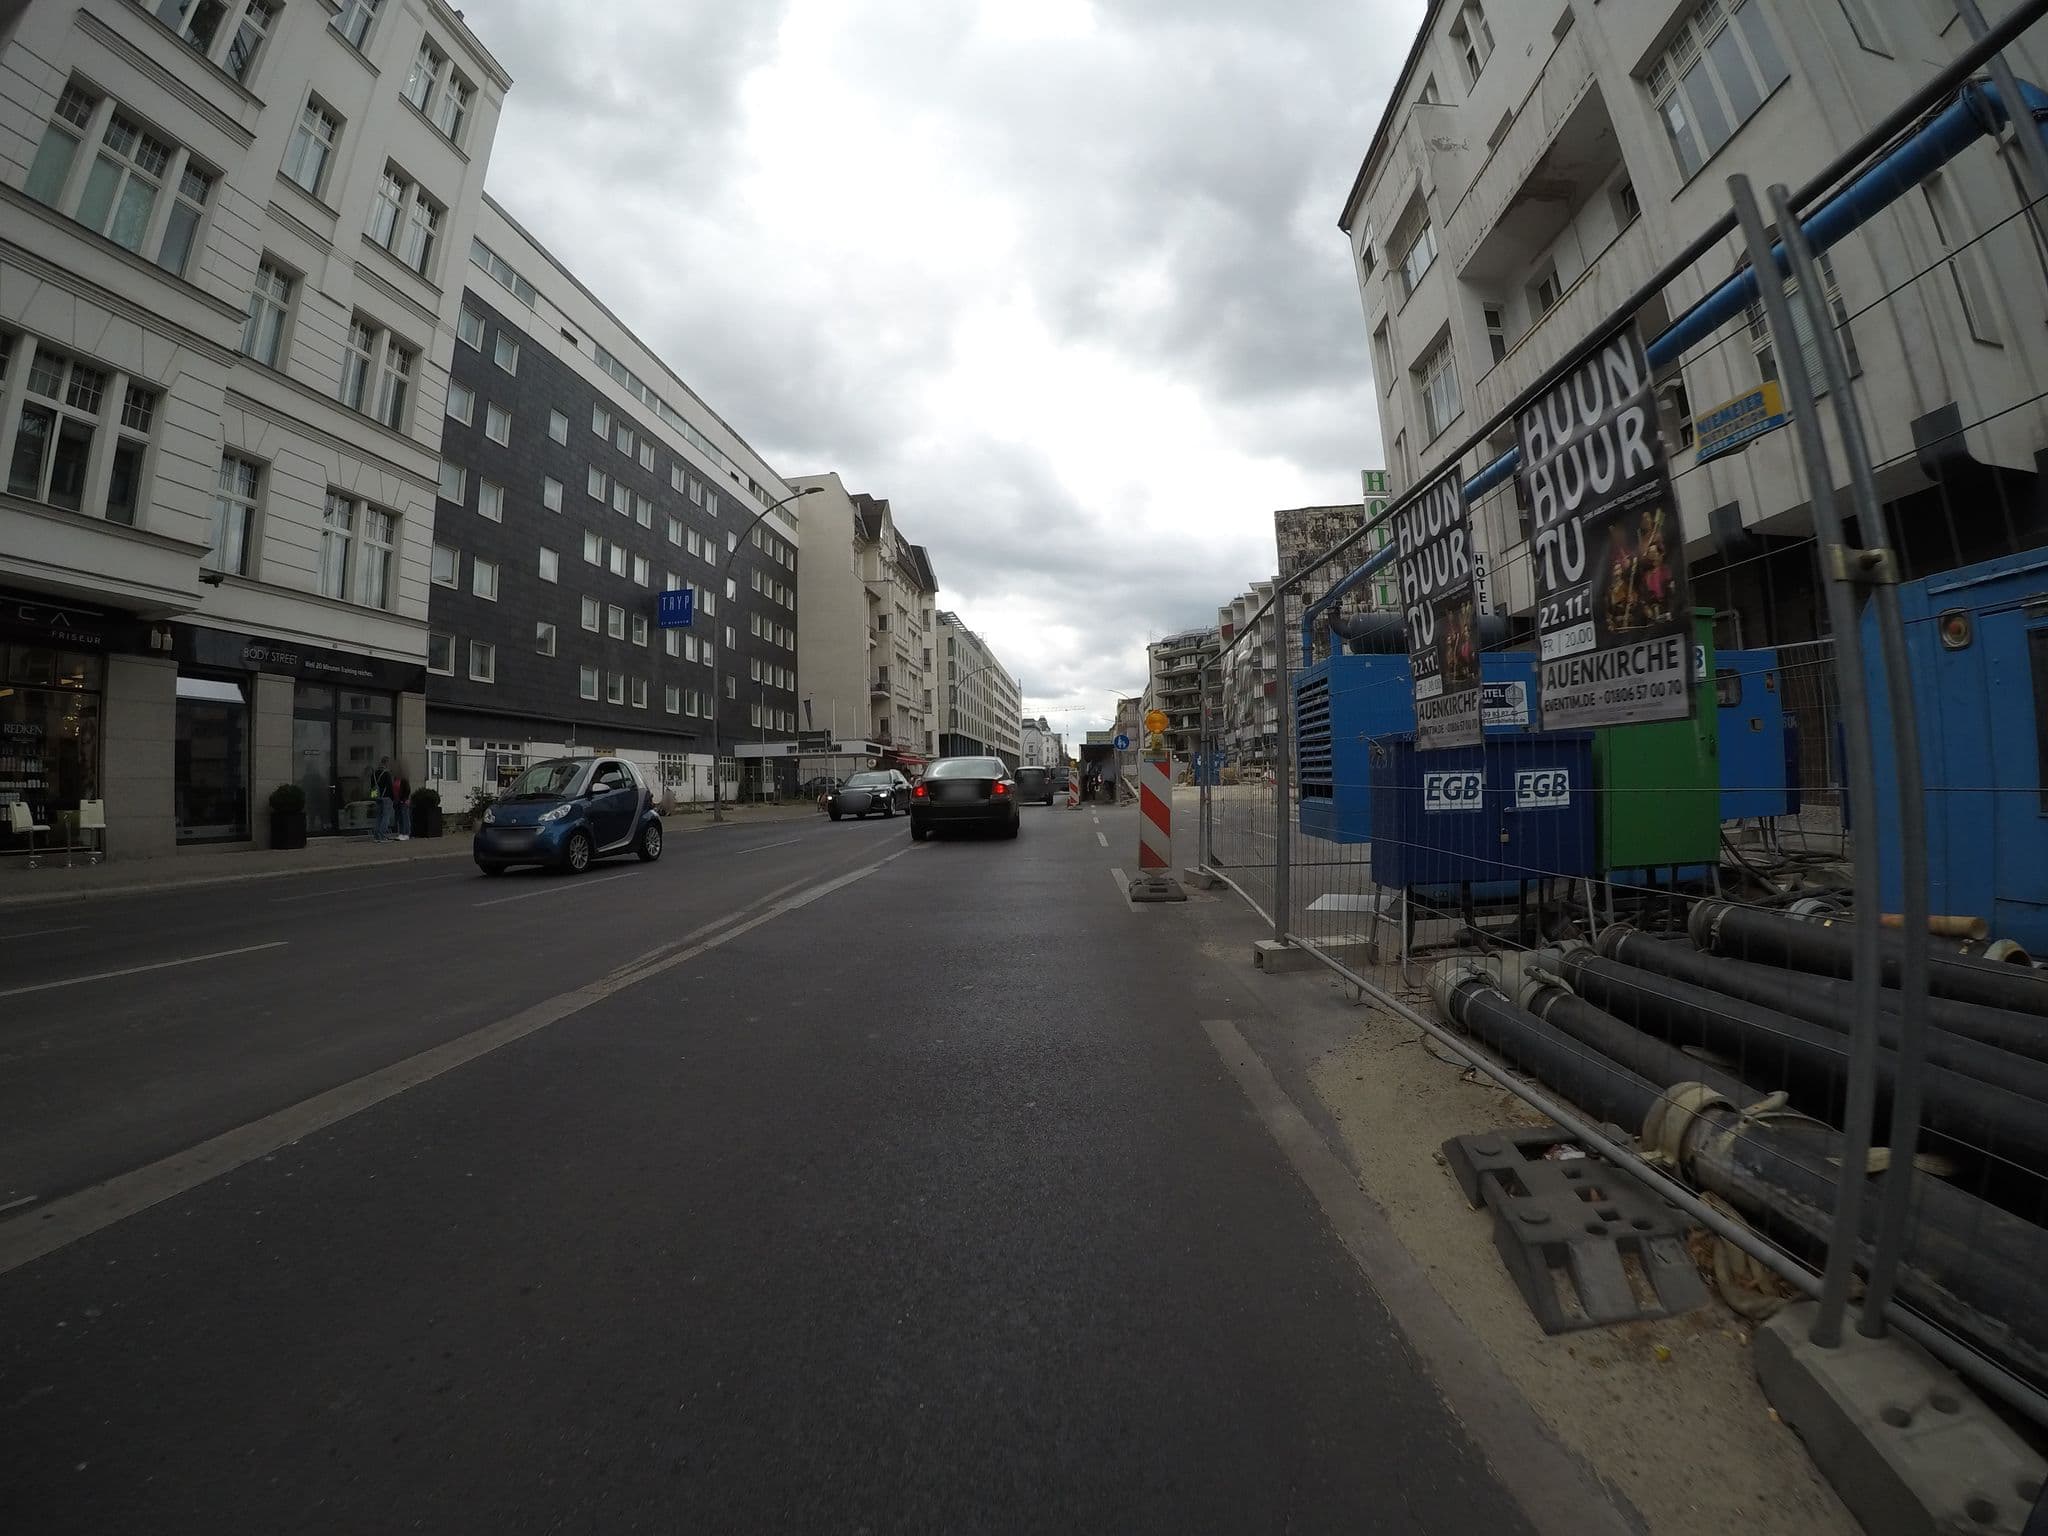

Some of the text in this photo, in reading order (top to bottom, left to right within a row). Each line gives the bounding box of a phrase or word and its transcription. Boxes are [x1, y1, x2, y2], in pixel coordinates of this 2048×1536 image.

[1522, 335, 1640, 467] HUUN
[1530, 406, 1656, 528] HUUR
[1400, 475, 1460, 557] HUUN
[1402, 527, 1469, 603] HUUR
[1536, 516, 1586, 591] TU
[662, 595, 690, 611] TRYP
[1475, 554, 1490, 616] HOTEL
[51, 630, 102, 645] FRISEUR
[1407, 599, 1436, 650] TU
[243, 647, 298, 665] BODY STREET
[1546, 639, 1679, 690] AUENKIRCHE
[1419, 691, 1478, 720] AUENKIRCHE
[1545, 692, 1596, 713] EVENTIM.DE
[3, 723, 43, 735] REDKEN
[1426, 776, 1480, 801] EGB
[1517, 773, 1567, 799] EGB
